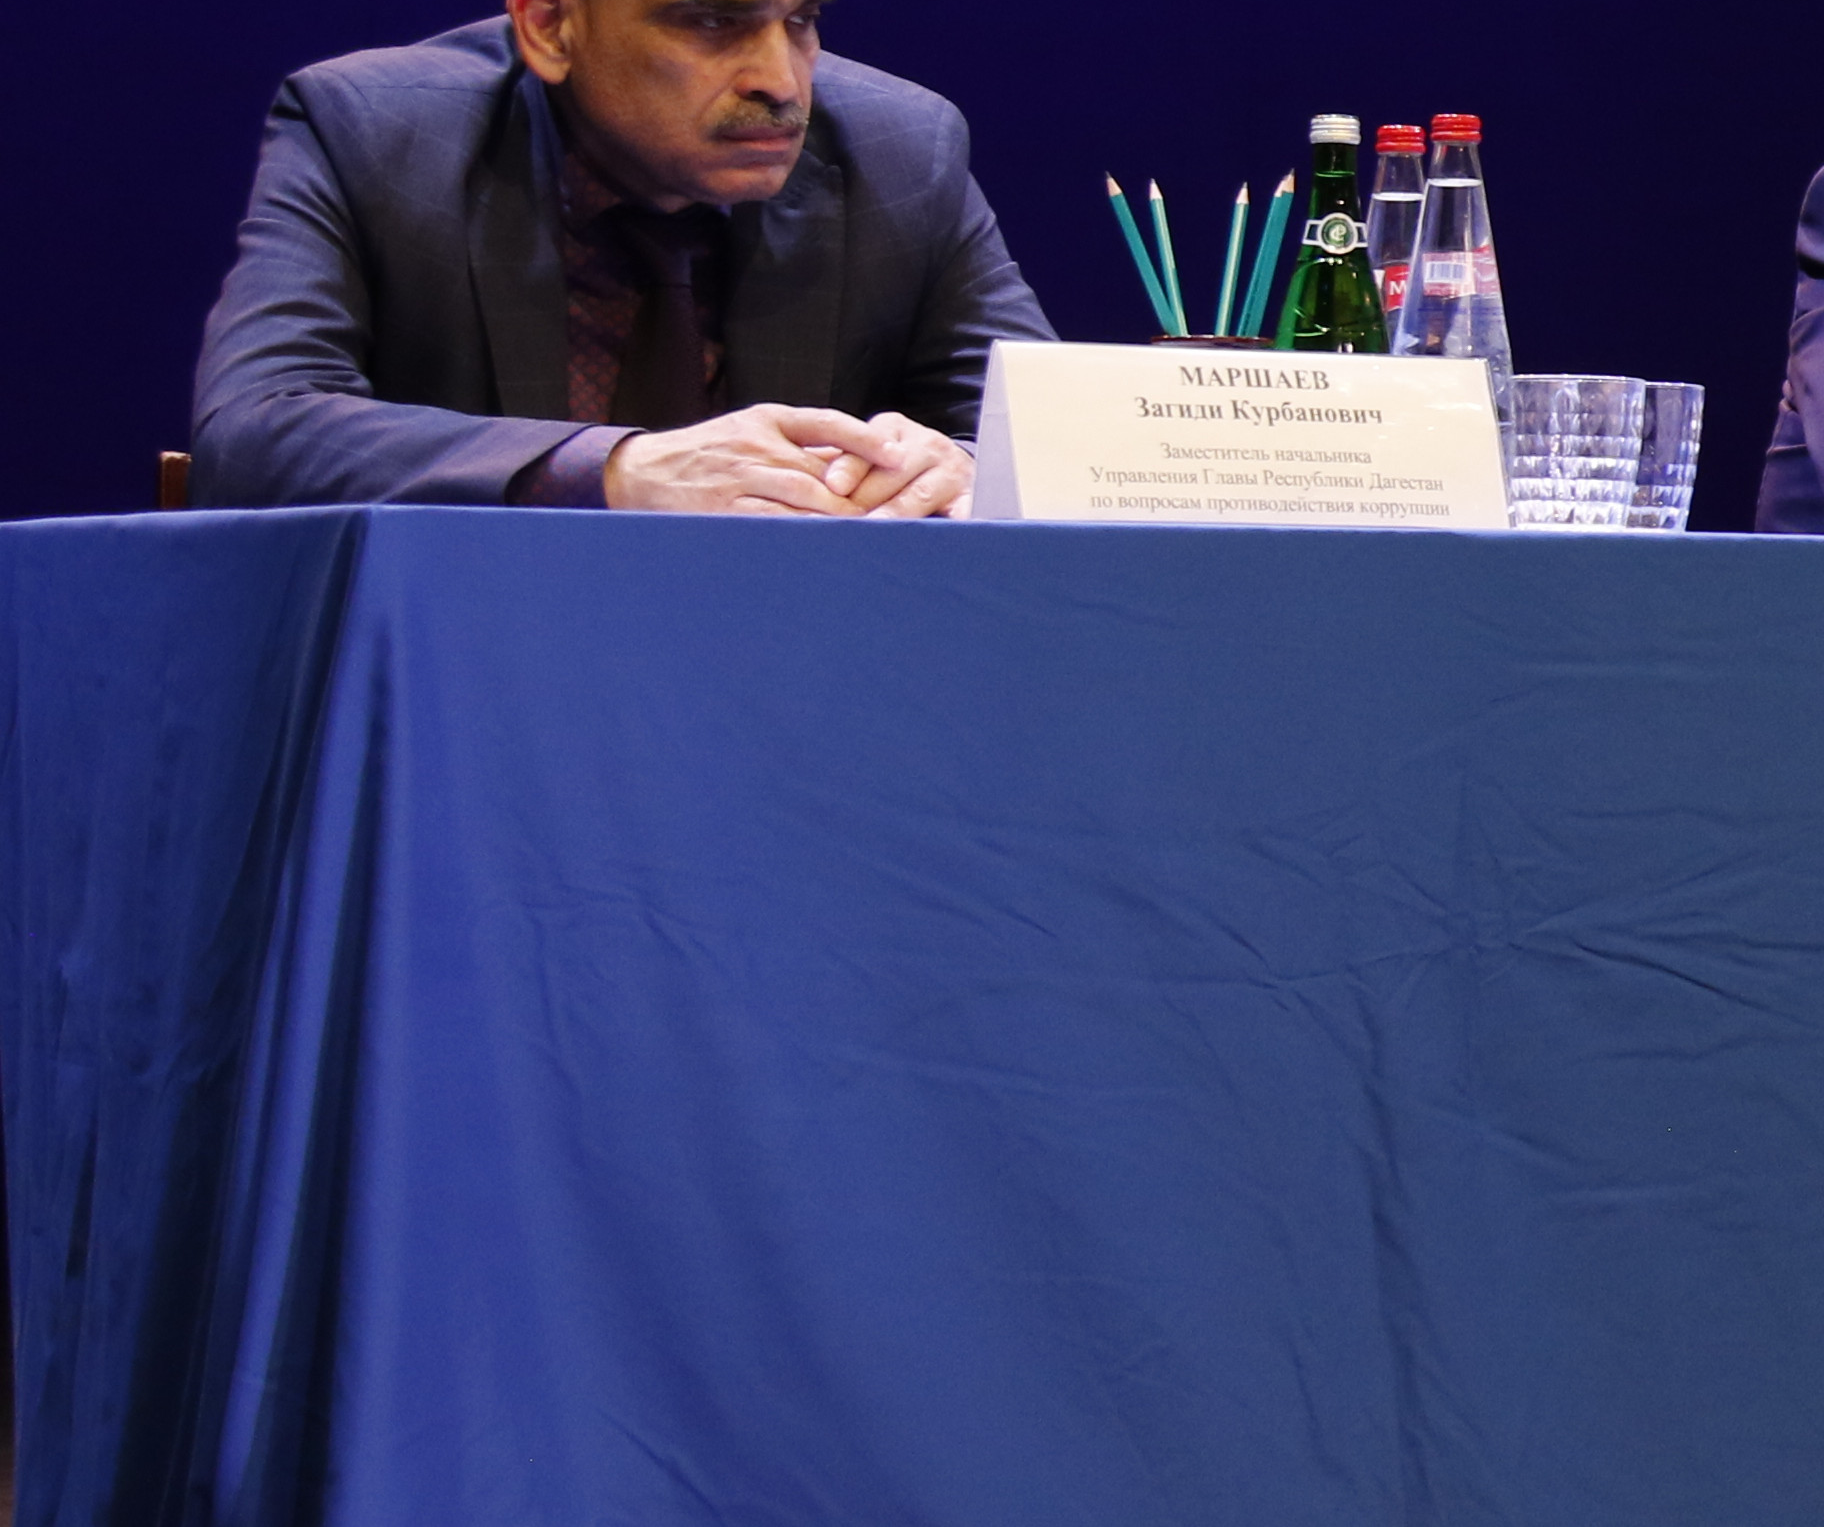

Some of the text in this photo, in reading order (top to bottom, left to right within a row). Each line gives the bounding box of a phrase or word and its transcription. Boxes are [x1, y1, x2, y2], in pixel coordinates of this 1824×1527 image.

[1179, 365, 1330, 390] МАРШАЕВ
[1134, 396, 1383, 427] Загиди Курбанович
[1160, 442, 1373, 465] Заместитель начальника
[1089, 466, 1445, 493] Управления Главы Республики Дагестан
[1089, 495, 1451, 519] по вопросам противодействия коррупции
